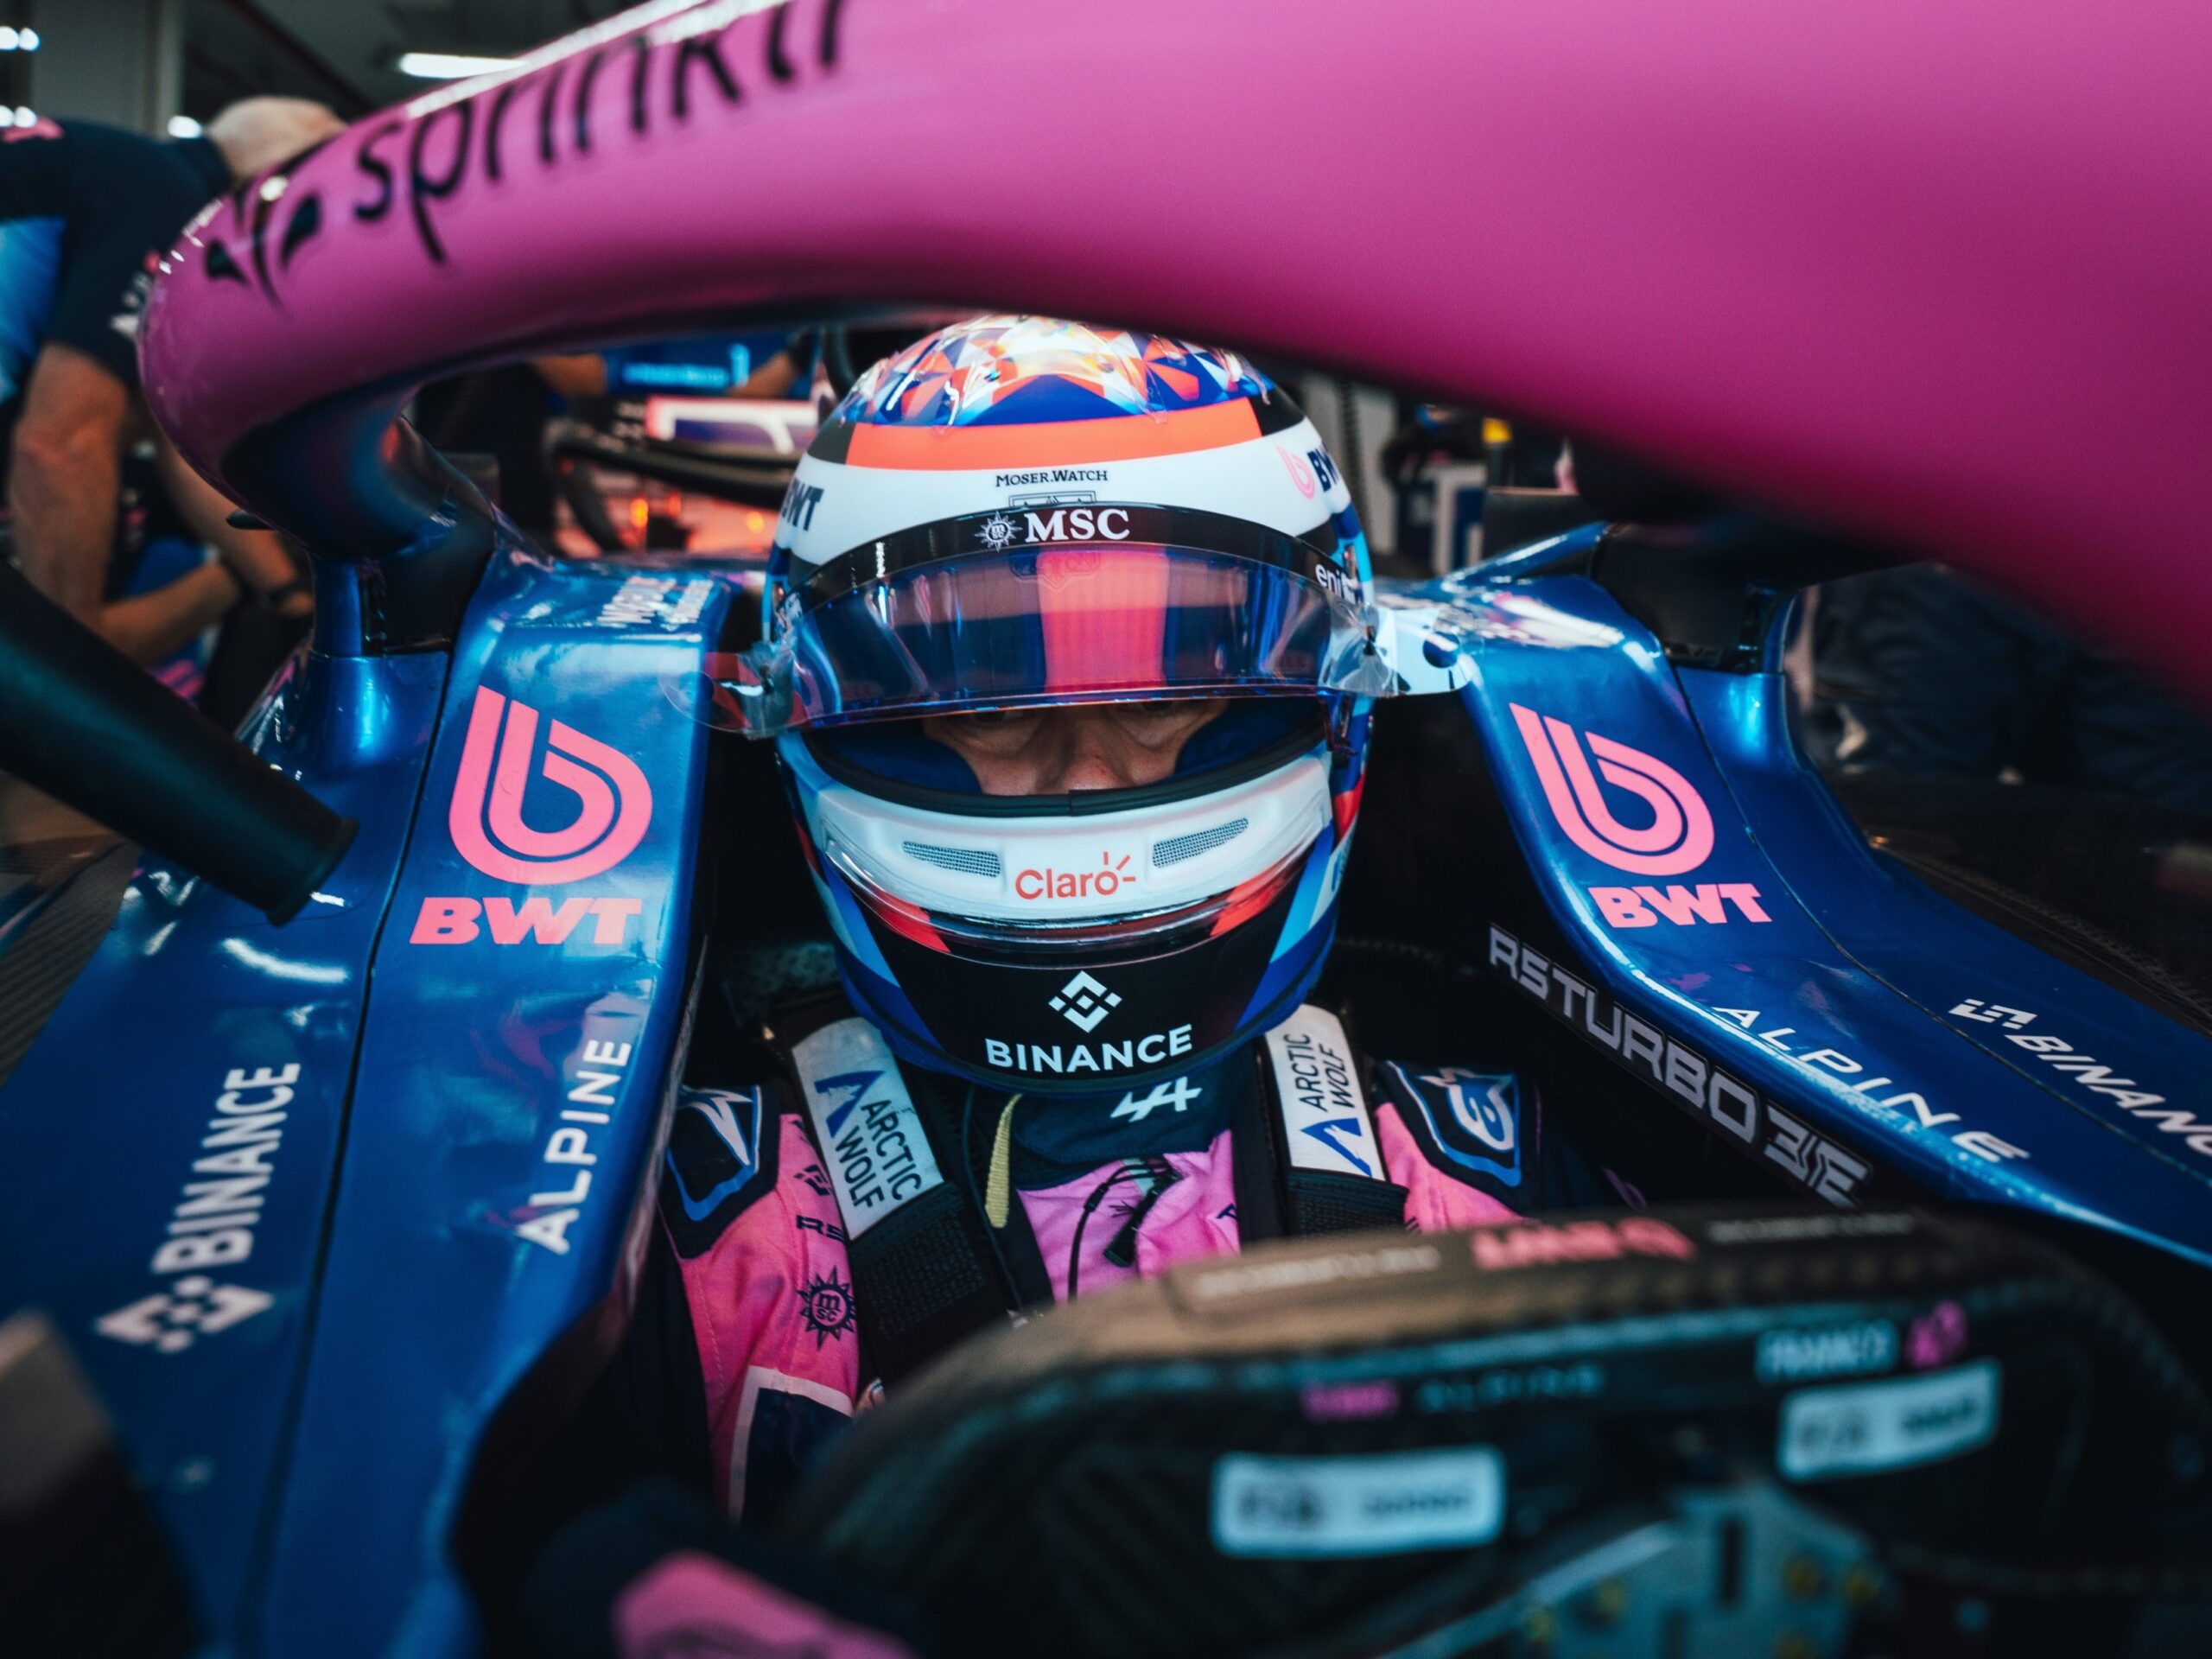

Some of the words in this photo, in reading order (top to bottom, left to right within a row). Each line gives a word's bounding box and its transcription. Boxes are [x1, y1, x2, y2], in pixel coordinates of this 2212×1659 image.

[353, 0, 854, 262] sprinkl
[1306, 446, 1338, 493] BW
[1024, 508, 1130, 543] MSC
[409, 896, 642, 944] BWT
[1015, 866, 1120, 900] Claro
[1587, 882, 1772, 928] BWT
[985, 1024, 1193, 1073] BINANCE
[1282, 1033, 1329, 1113] ARCTIC
[1318, 1042, 1356, 1109] WOLF
[1712, 1006, 2031, 1163] ALPINE
[2003, 1033, 2212, 1158] BINAN
[150, 1063, 302, 1276] BINANCE
[516, 1039, 633, 1255] ALPINE
[834, 1125, 886, 1208] WOLF
[860, 1099, 923, 1201] ARCTIC
